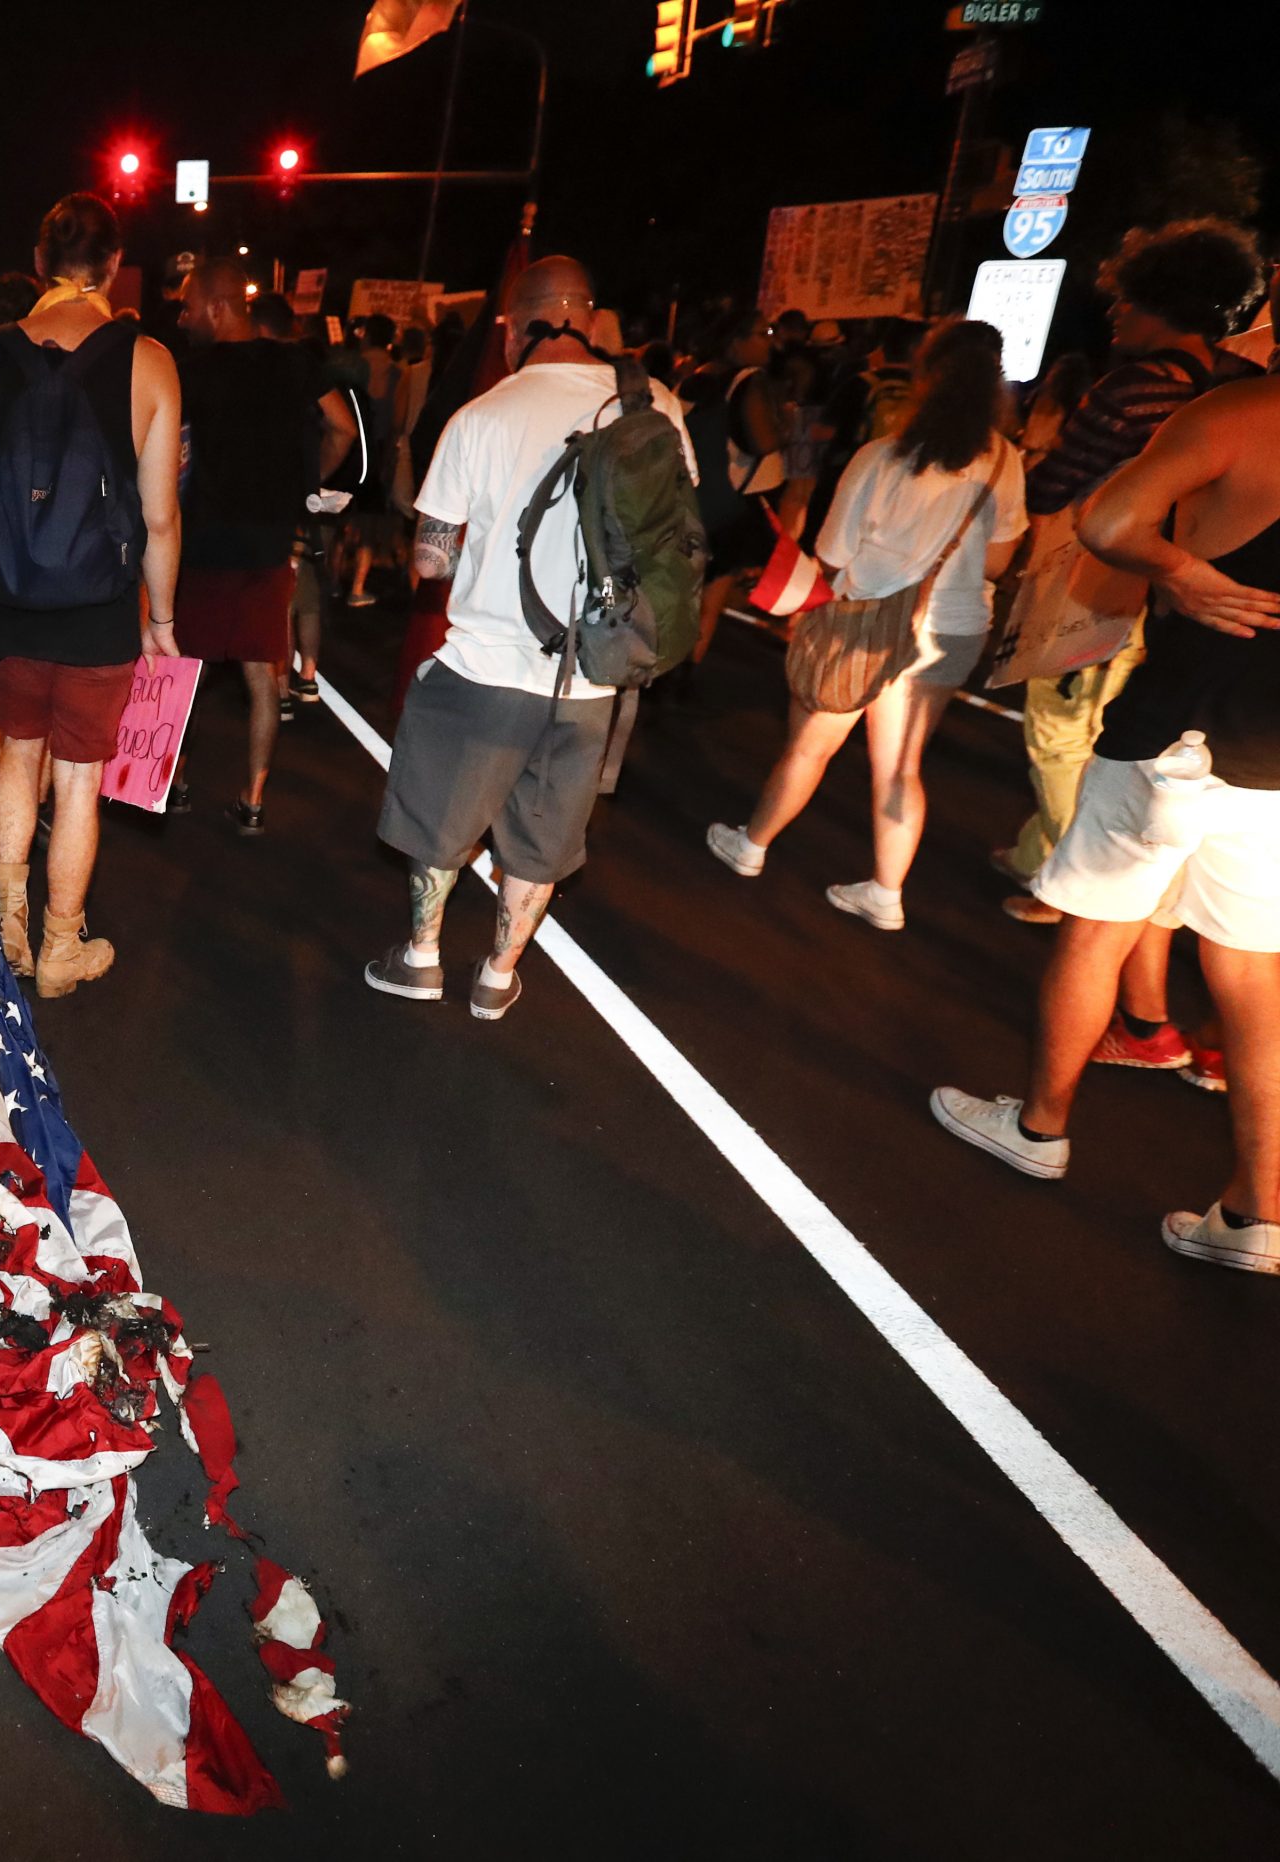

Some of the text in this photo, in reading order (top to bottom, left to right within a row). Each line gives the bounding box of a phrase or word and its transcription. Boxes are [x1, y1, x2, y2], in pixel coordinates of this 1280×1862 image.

[963, 2, 1021, 22] BIGLER
[1041, 135, 1072, 156] TO
[1020, 167, 1073, 190] SOUTH
[1012, 210, 1057, 246] 95
[131, 674, 175, 721] Jone
